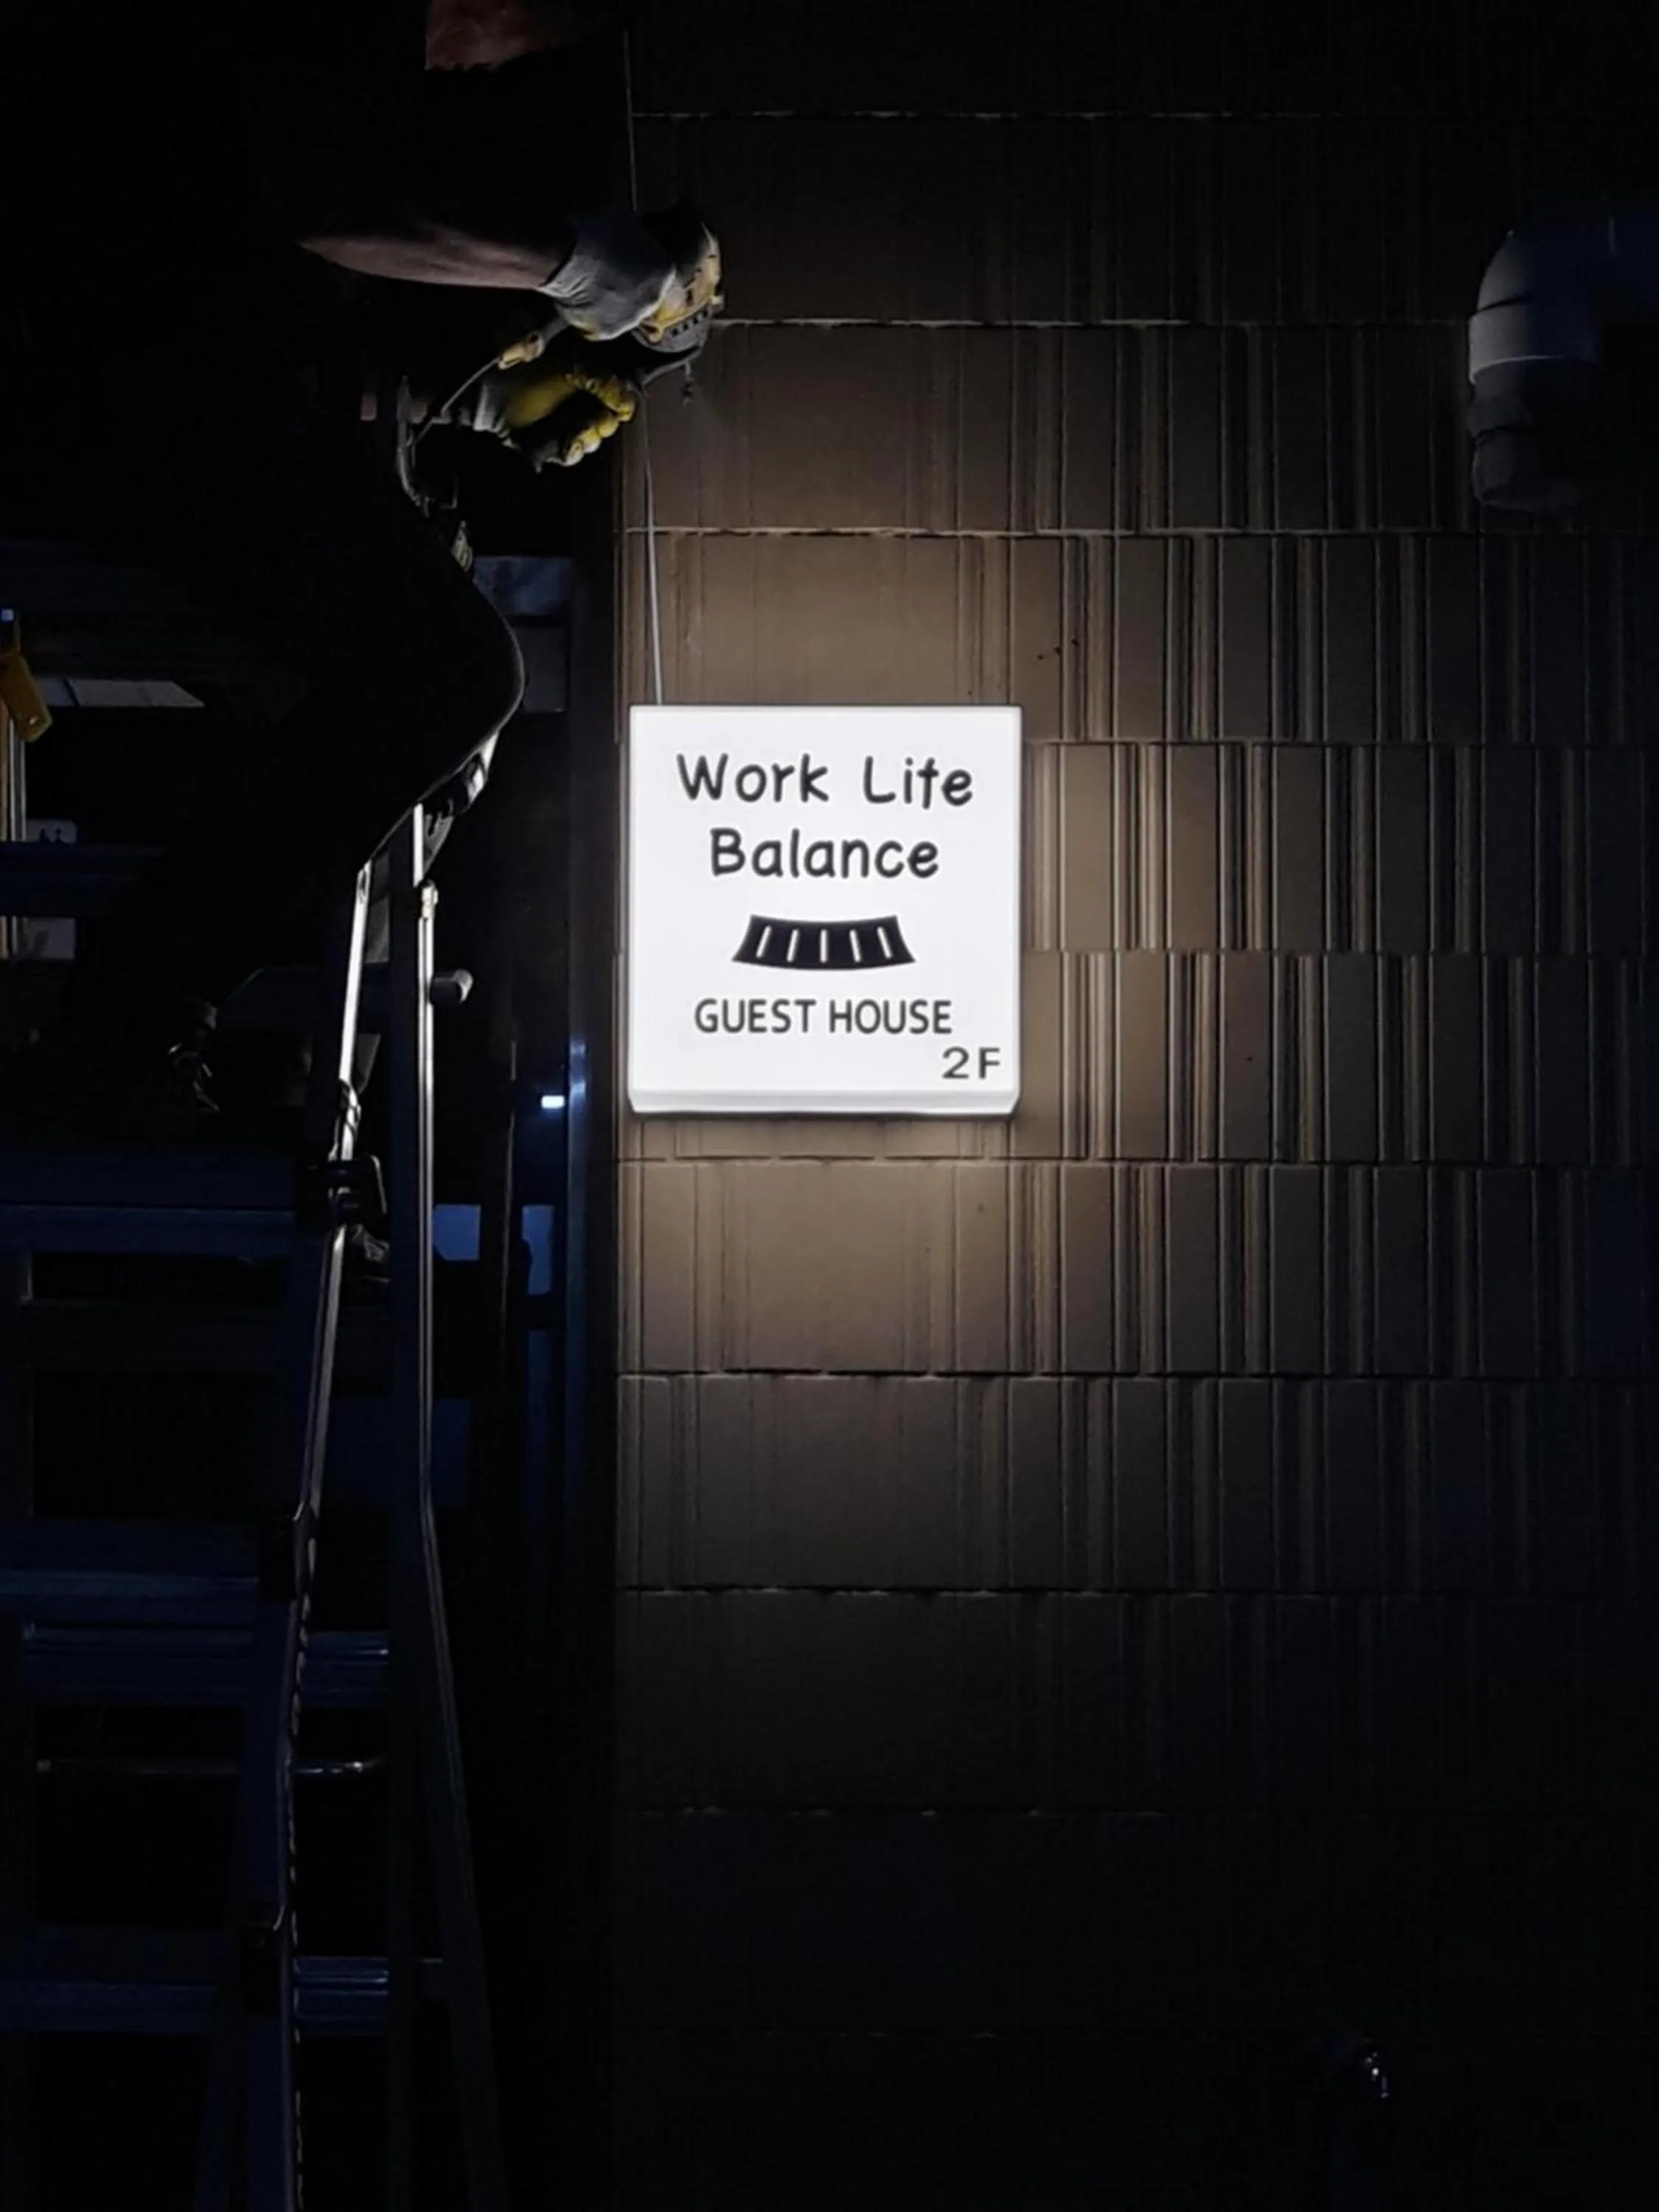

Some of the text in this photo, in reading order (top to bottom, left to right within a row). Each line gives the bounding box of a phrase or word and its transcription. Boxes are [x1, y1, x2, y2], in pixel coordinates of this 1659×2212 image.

[677, 754, 829, 803] Work
[710, 828, 939, 879] Balance
[695, 998, 953, 1035] GUEST HOUSE
[943, 1047, 1001, 1079] 2F
